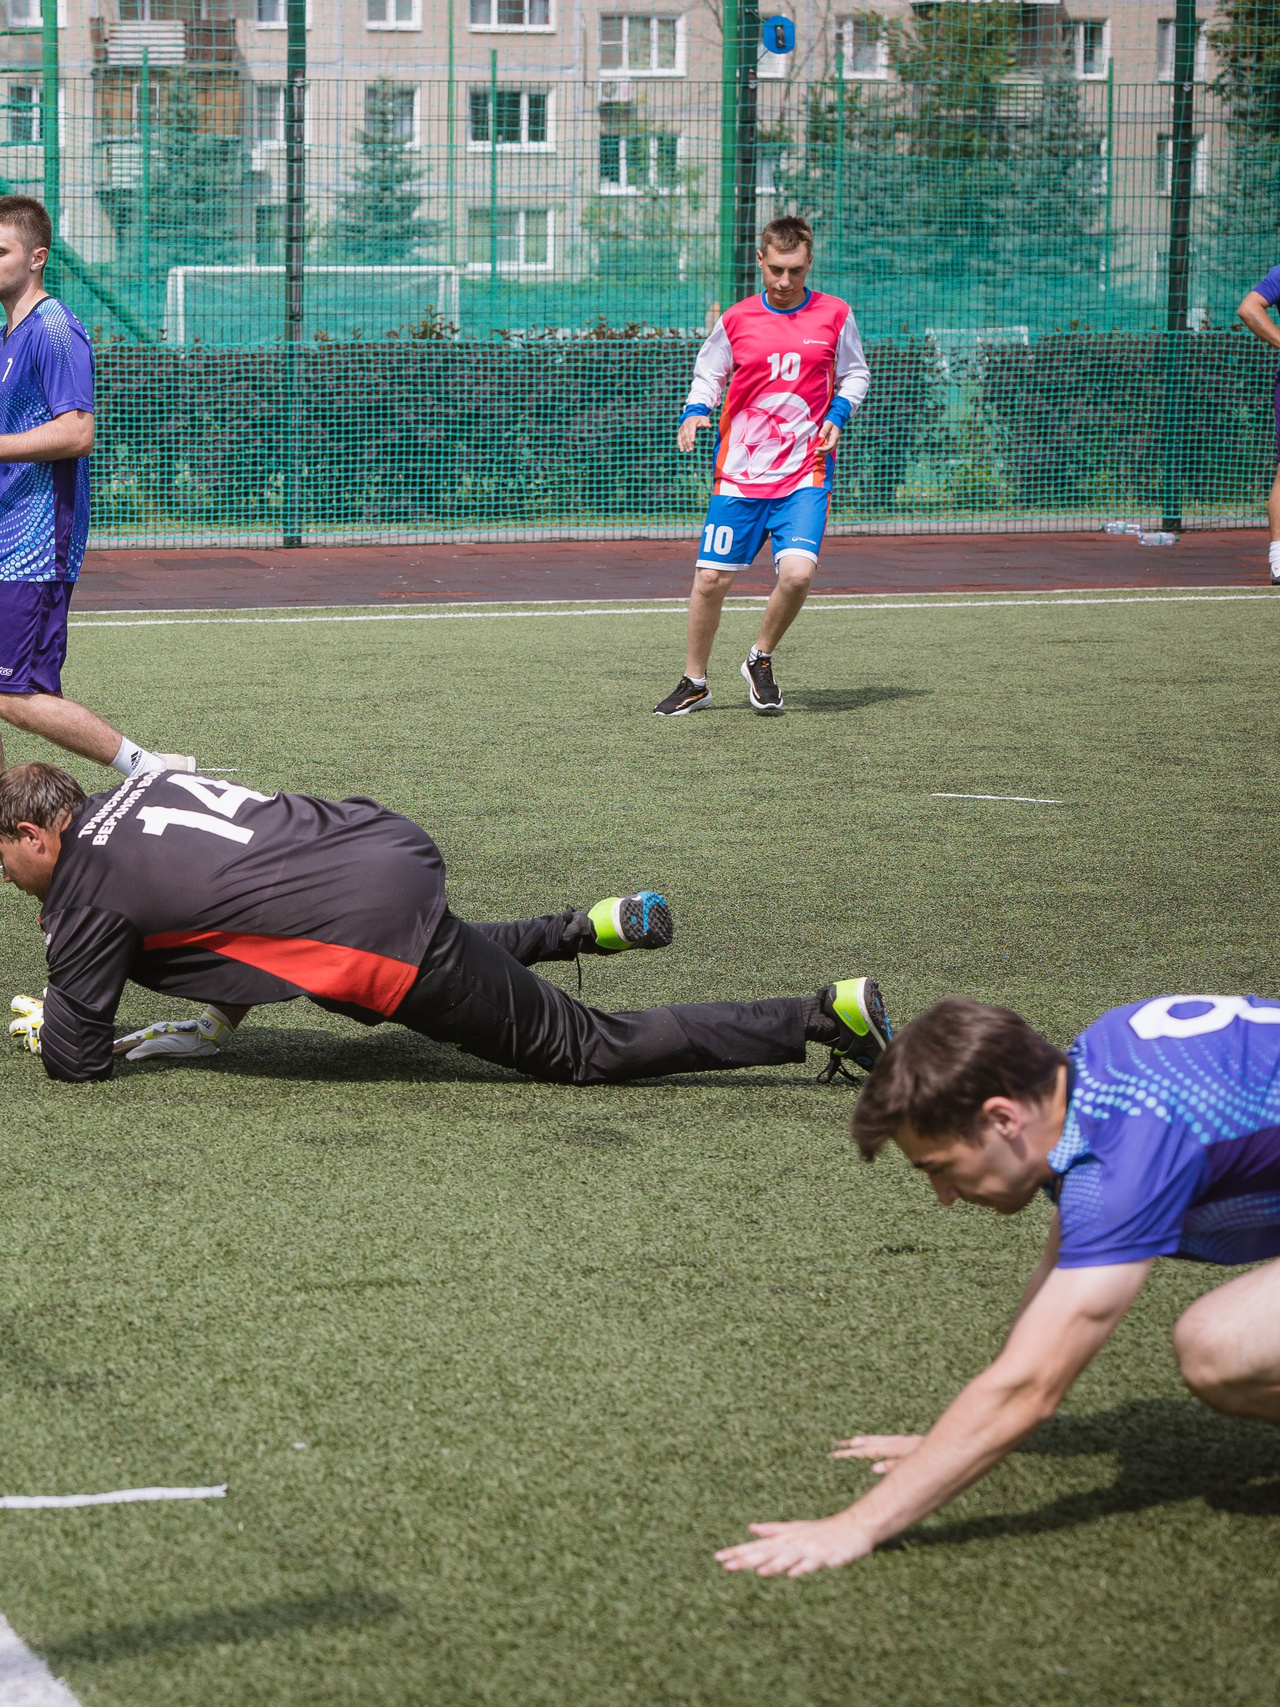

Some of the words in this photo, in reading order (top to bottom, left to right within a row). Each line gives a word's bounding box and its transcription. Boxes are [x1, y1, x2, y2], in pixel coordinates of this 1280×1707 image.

[766, 351, 802, 382] 10
[703, 523, 734, 556] 10
[135, 772, 279, 845] 14
